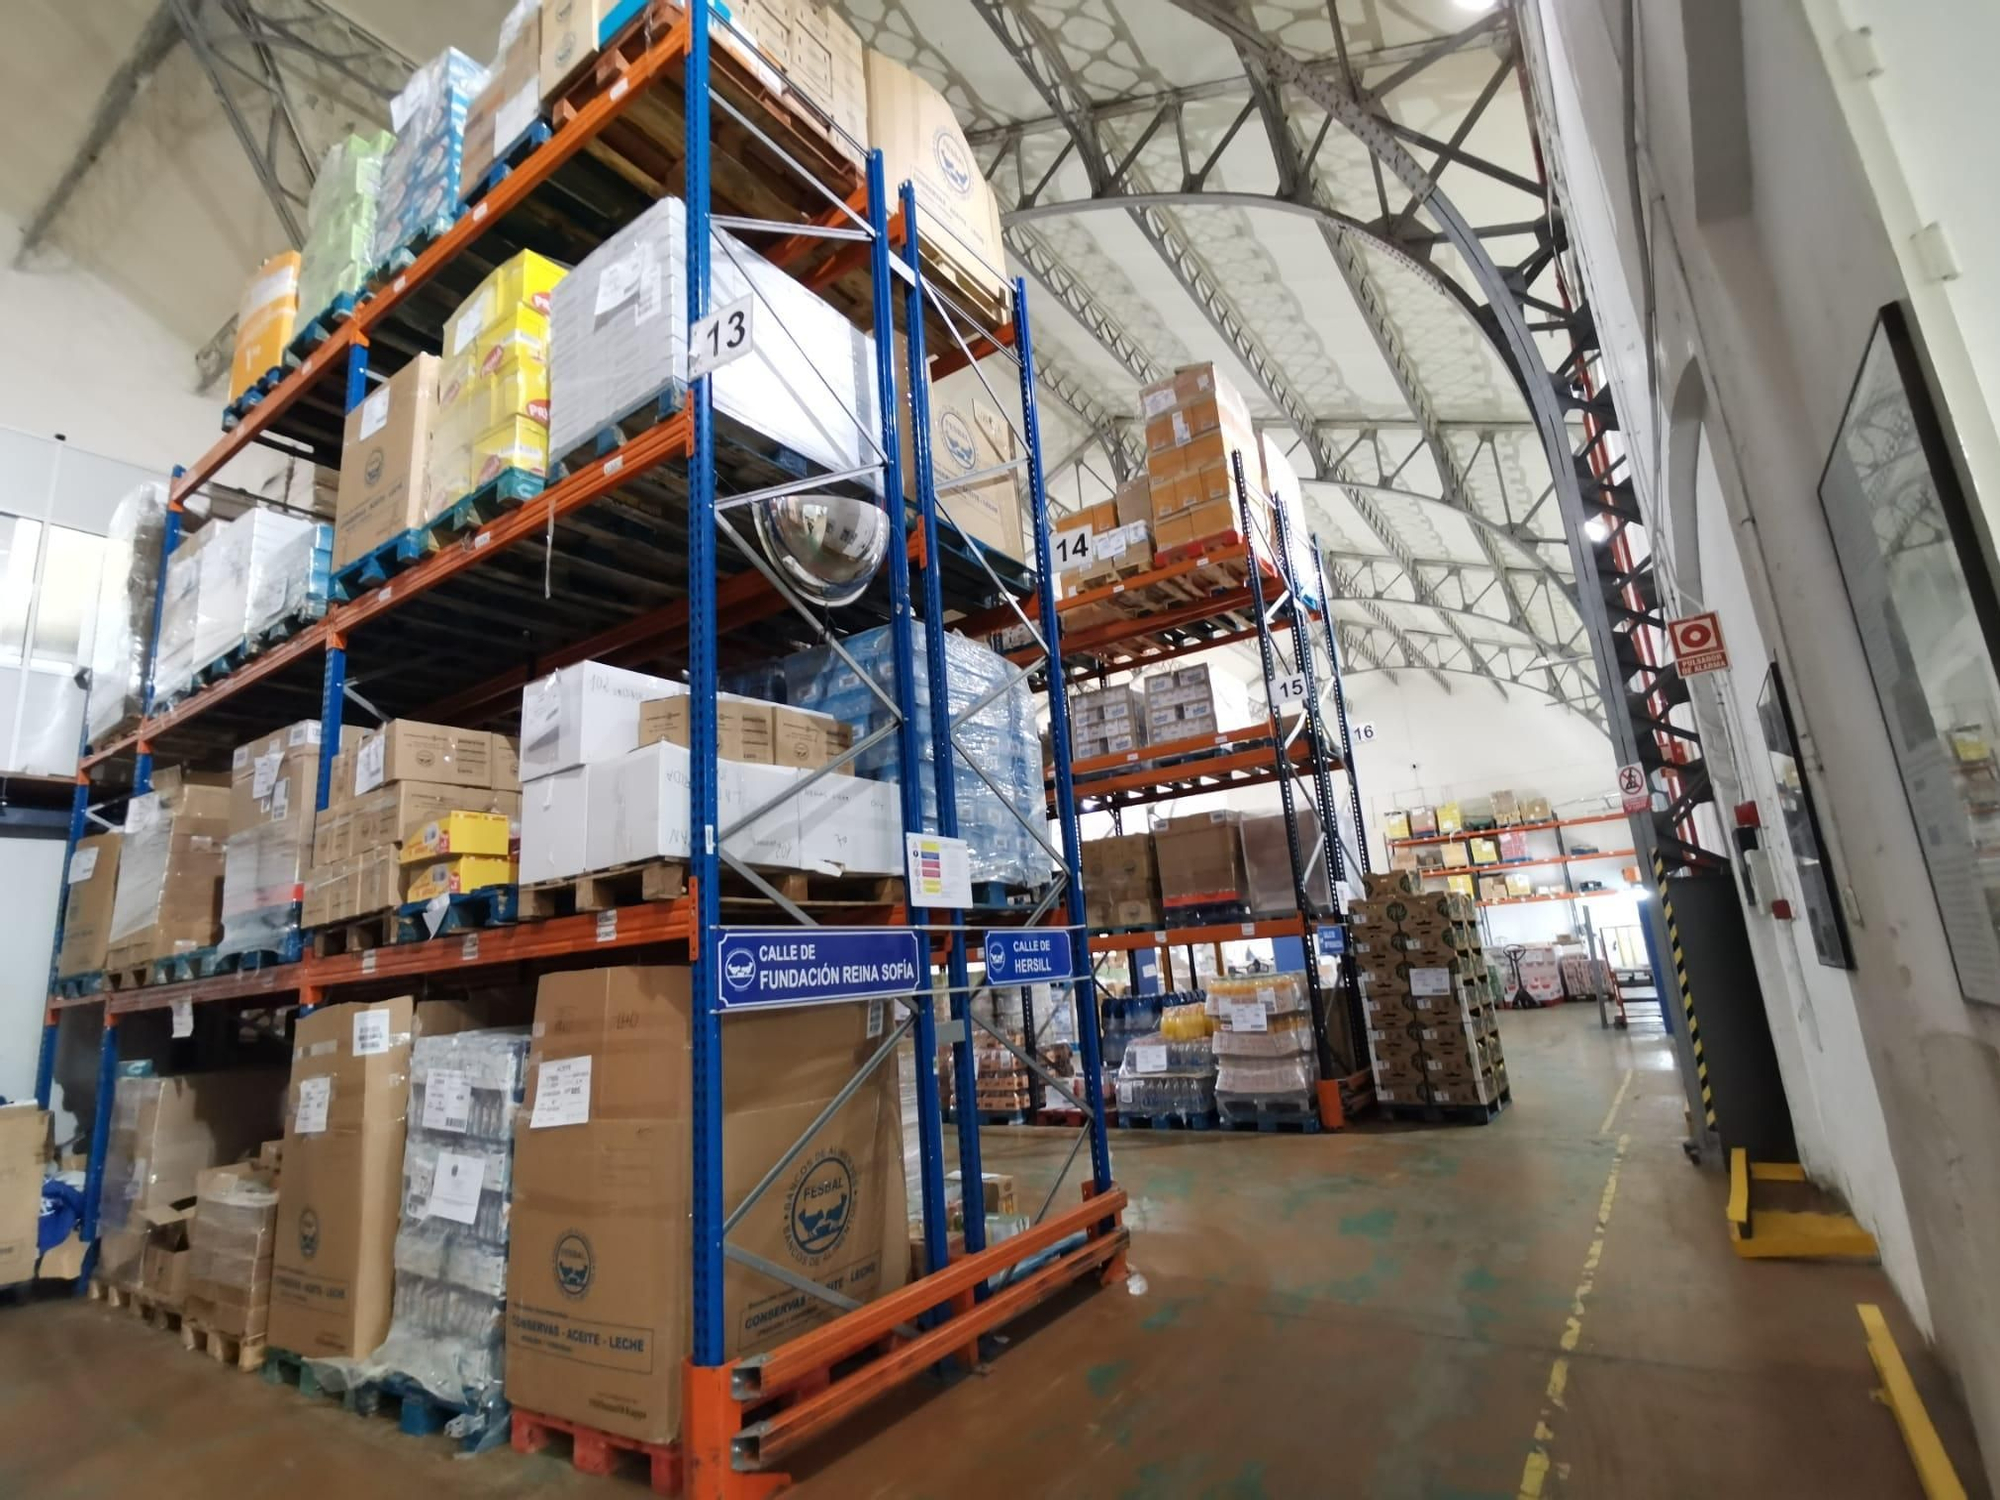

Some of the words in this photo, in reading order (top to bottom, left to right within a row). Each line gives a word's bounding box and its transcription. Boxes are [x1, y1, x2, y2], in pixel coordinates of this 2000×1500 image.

[706, 310, 746, 358] 13
[529, 404, 549, 420] PRI
[1056, 532, 1089, 562] 14
[1681, 653, 1723, 667] PULSADOR
[1681, 667, 1693, 675] DE
[1694, 660, 1727, 673] ALARMA
[1279, 679, 1304, 698] 15
[1354, 725, 1375, 741] 16
[759, 944, 798, 962] CALLE
[800, 944, 816, 960] DE
[1013, 940, 1040, 953] CALLE
[1040, 939, 1051, 952] DE
[759, 961, 840, 990] FUNDACIÓN
[842, 963, 879, 984] REINA
[881, 959, 915, 982] SOFÍA
[1014, 957, 1052, 974] HERSILL
[804, 1177, 843, 1200] FESBAL
[744, 1295, 806, 1330] CONSERVAS
[850, 1261, 877, 1283] LECHE
[566, 1329, 600, 1346] ACEITE
[608, 1335, 645, 1353] LECHE
